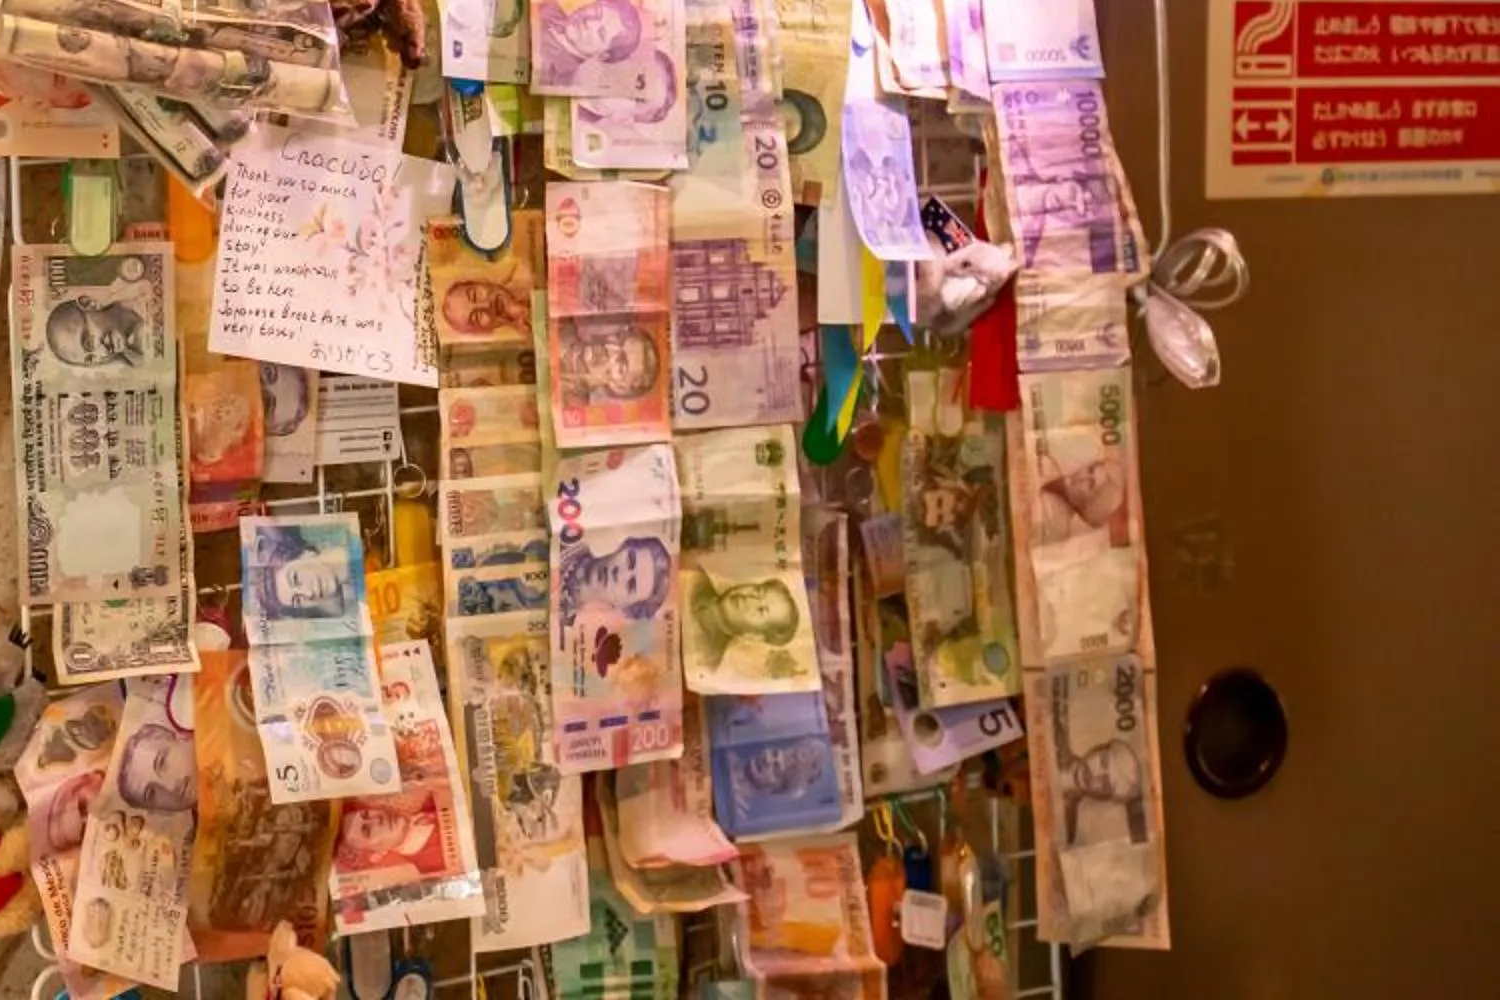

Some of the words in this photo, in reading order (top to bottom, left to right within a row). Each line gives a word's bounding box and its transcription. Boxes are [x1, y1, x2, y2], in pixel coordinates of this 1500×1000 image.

[711, 41, 727, 74] TEN
[704, 79, 730, 113] 10
[755, 135, 780, 171] 20
[257, 191, 291, 211] your
[221, 278, 241, 294] to
[677, 365, 711, 416] 20
[1100, 384, 1123, 447] 5000
[556, 477, 585, 545] 200
[1113, 664, 1138, 733] 2000
[631, 724, 672, 750] 200
[977, 706, 1014, 737] 5
